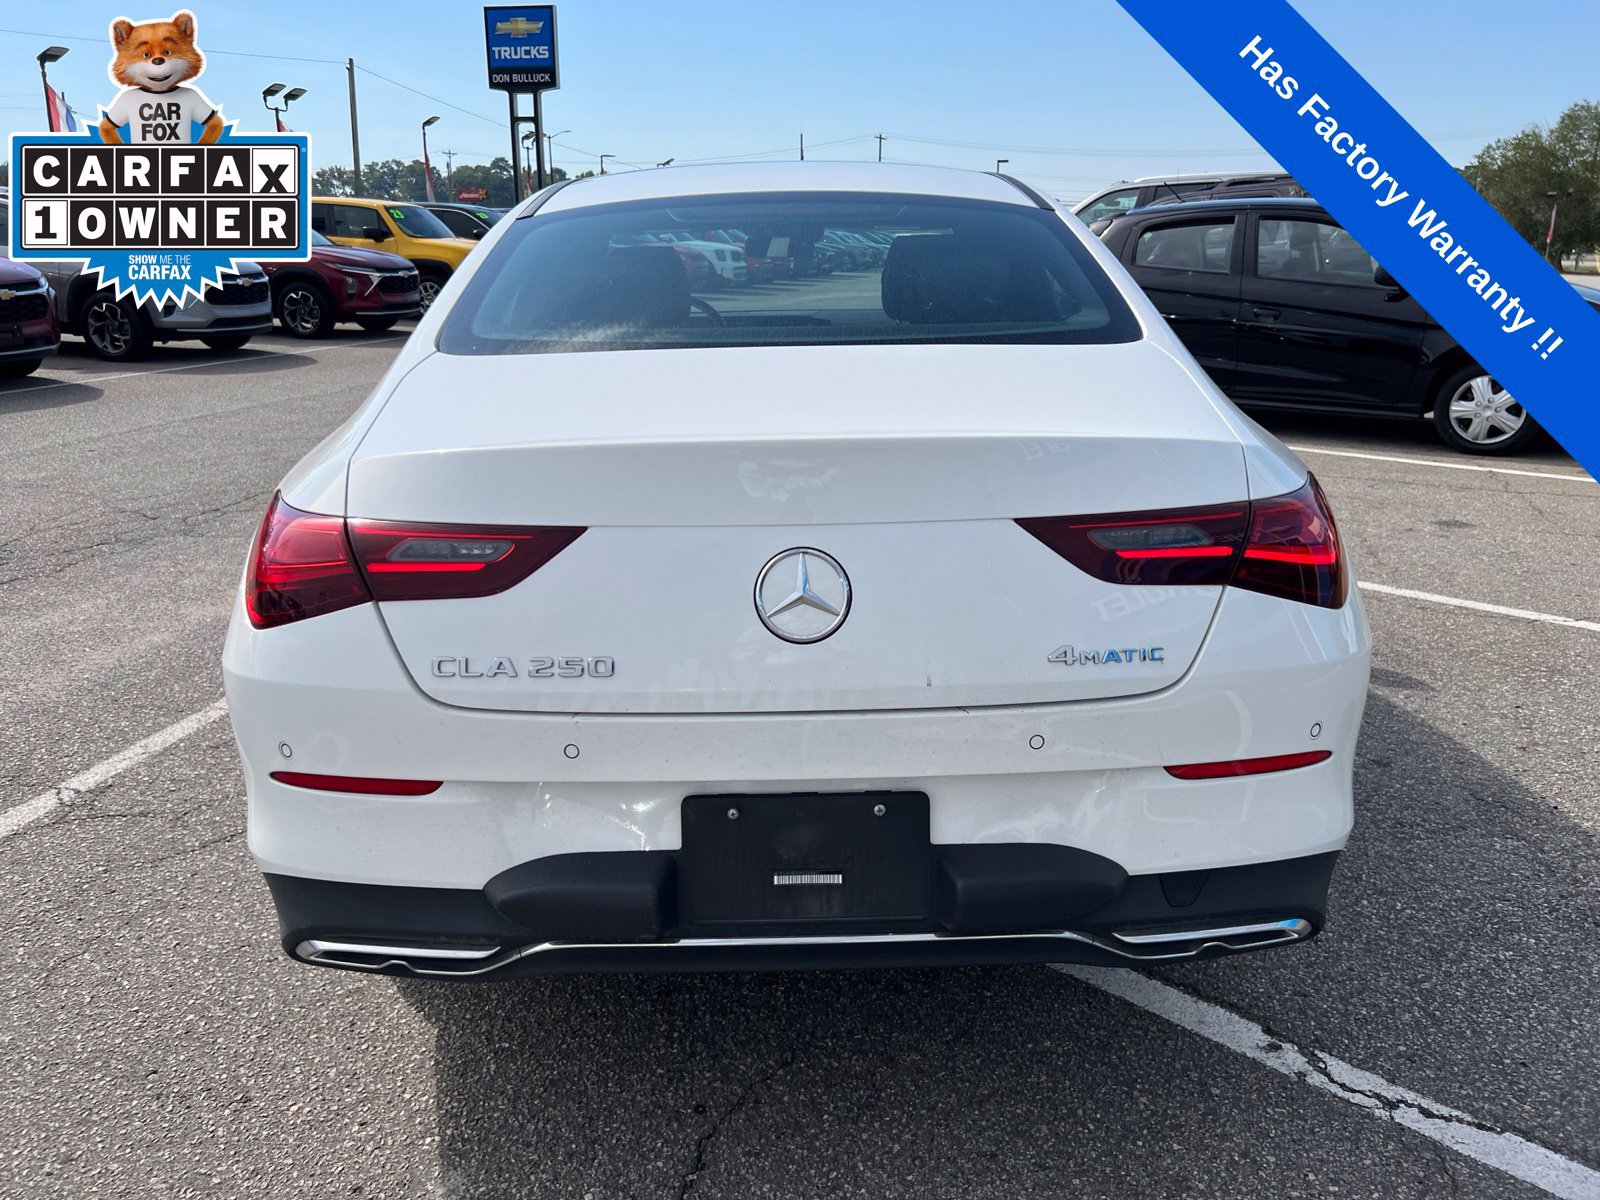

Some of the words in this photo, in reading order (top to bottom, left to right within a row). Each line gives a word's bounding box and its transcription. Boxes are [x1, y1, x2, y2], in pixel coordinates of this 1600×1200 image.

[492, 46, 549, 59] TRUCKS
[493, 74, 510, 82] DON
[512, 73, 551, 82] BULLUCK
[1047, 644, 1165, 666] 4MATIC
[431, 656, 518, 678] CLA
[527, 655, 616, 678] 250
